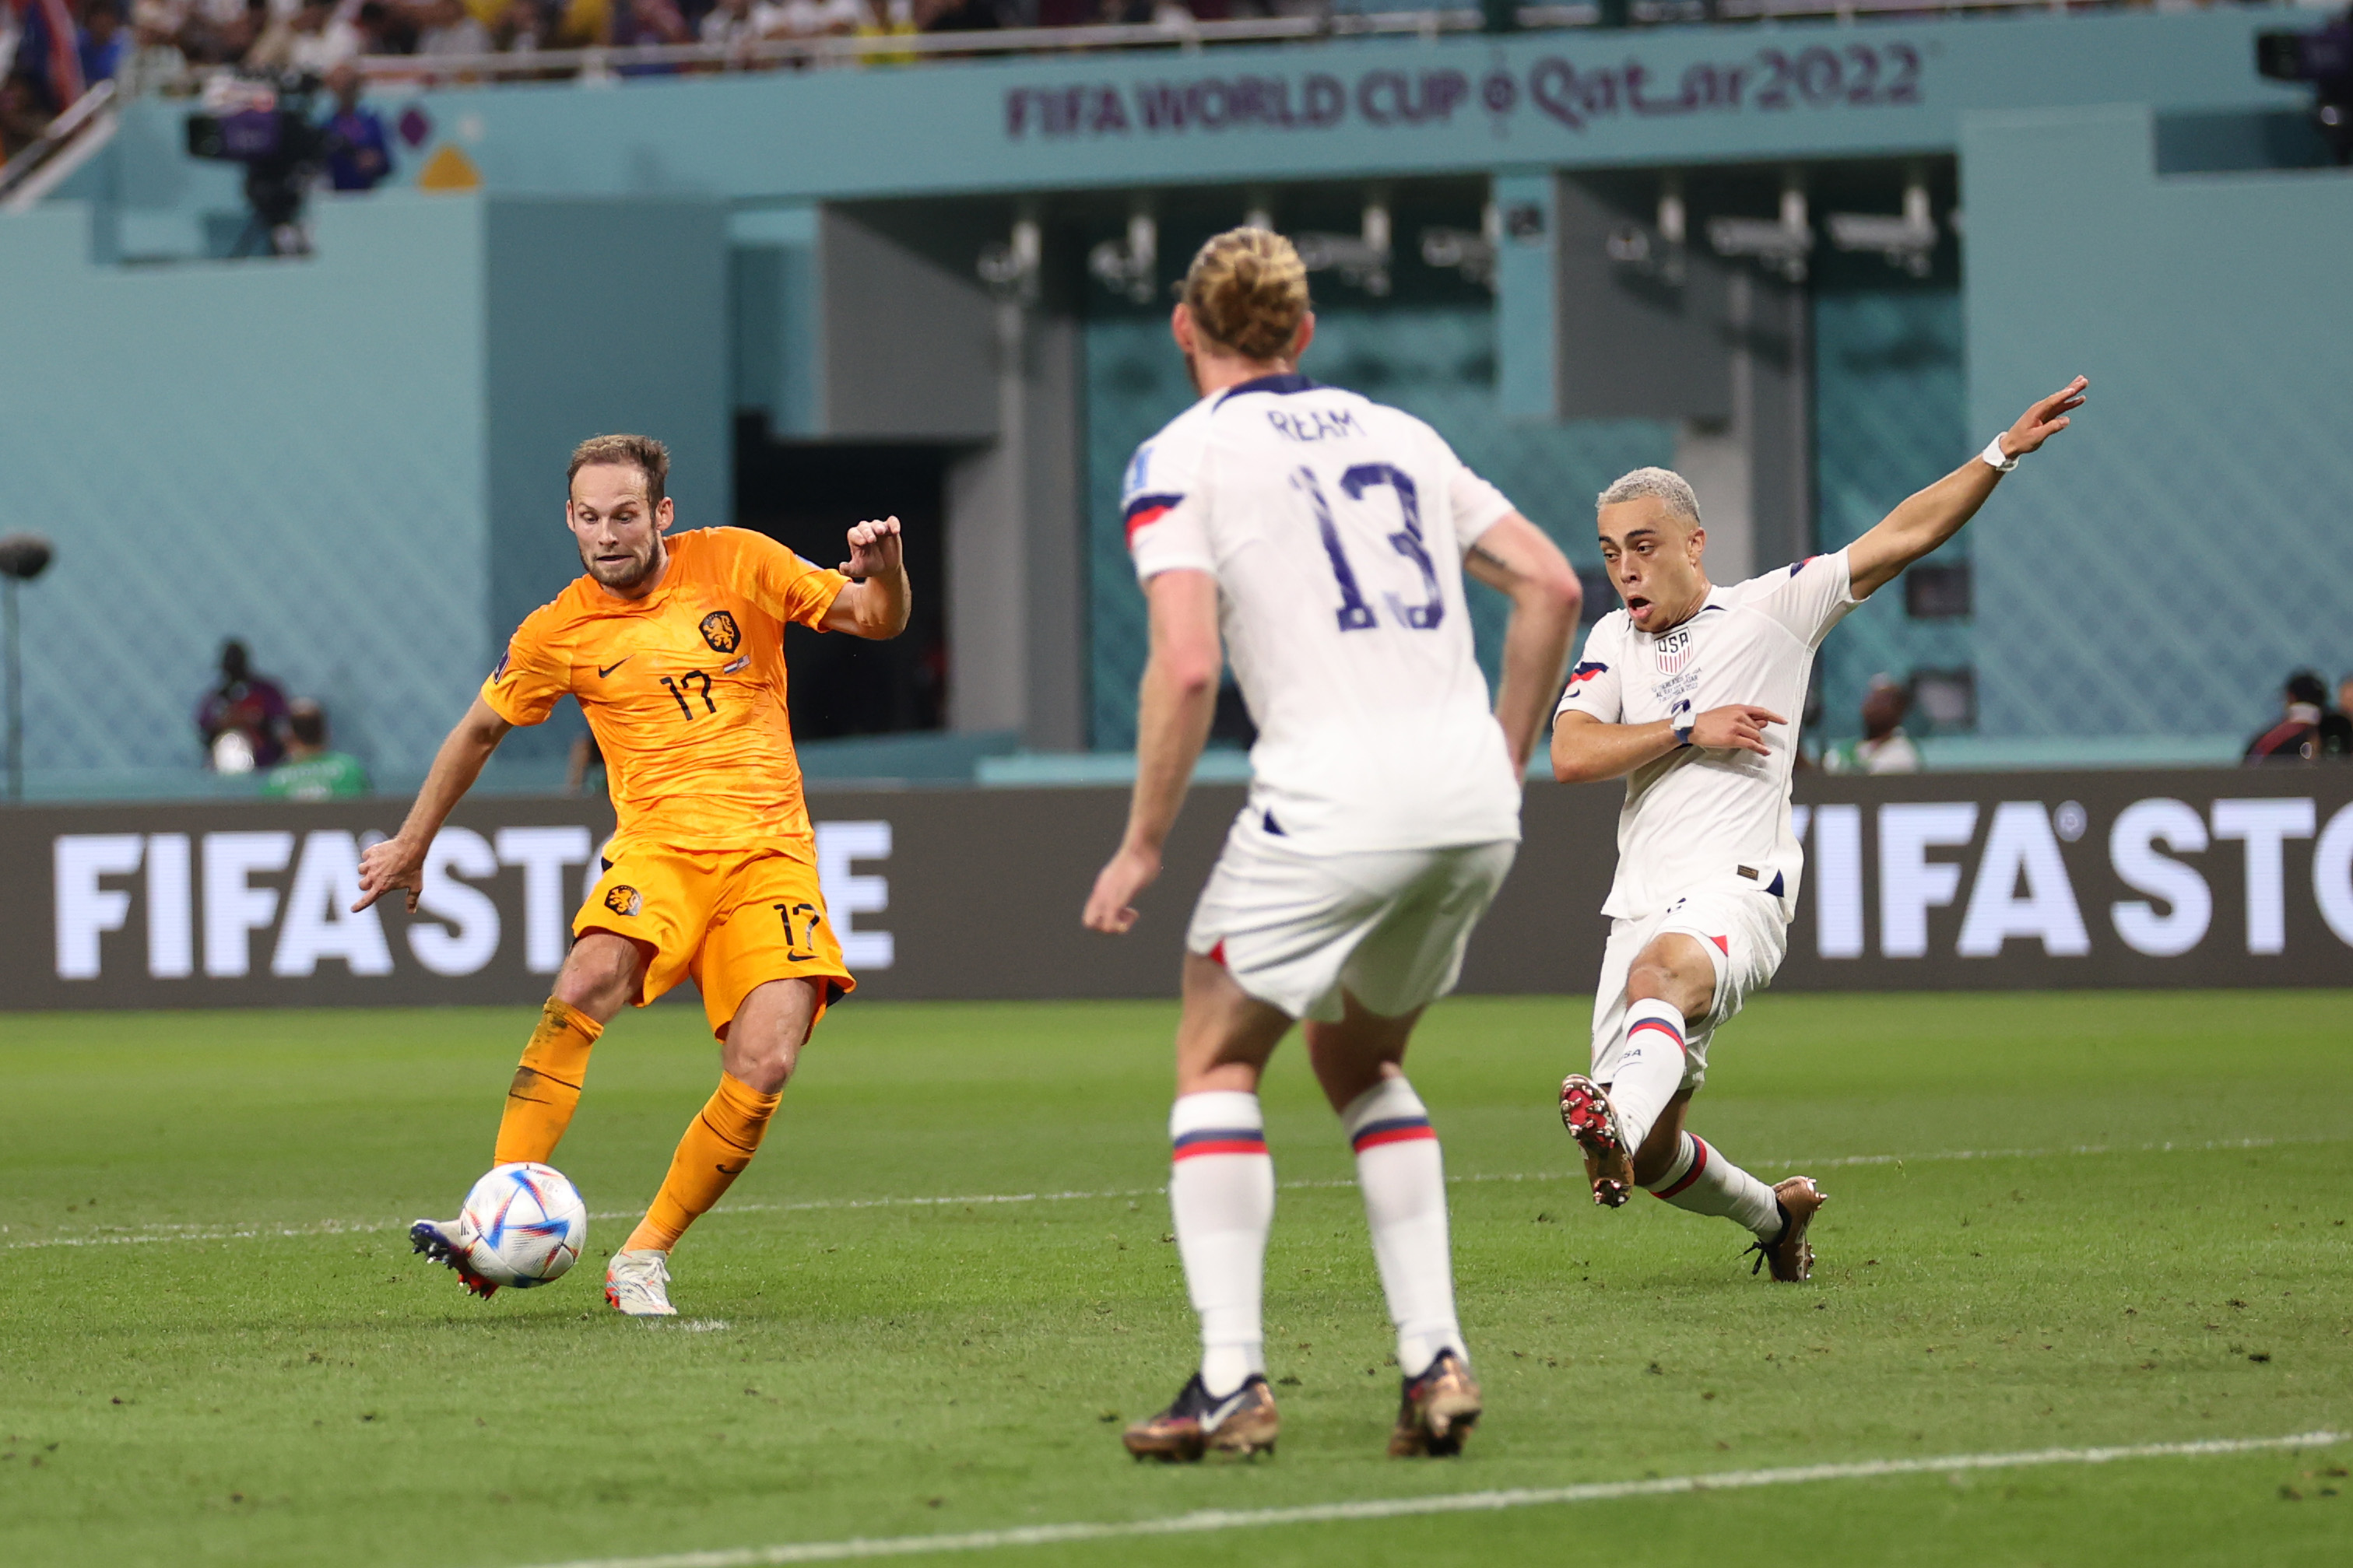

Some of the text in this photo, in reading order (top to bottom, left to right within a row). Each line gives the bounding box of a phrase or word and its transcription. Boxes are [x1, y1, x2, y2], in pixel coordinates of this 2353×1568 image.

[1006, 84, 1129, 139] FIFA
[1137, 72, 1347, 131] WORLD
[1357, 68, 1470, 128] CUP
[1266, 407, 1368, 442] REAM
[1288, 461, 1445, 632] 13
[1658, 631, 1688, 654] USA
[659, 669, 718, 721] 17
[54, 820, 894, 980] FIFA STE
[1791, 800, 2091, 959] IFA
[773, 903, 820, 952] 17
